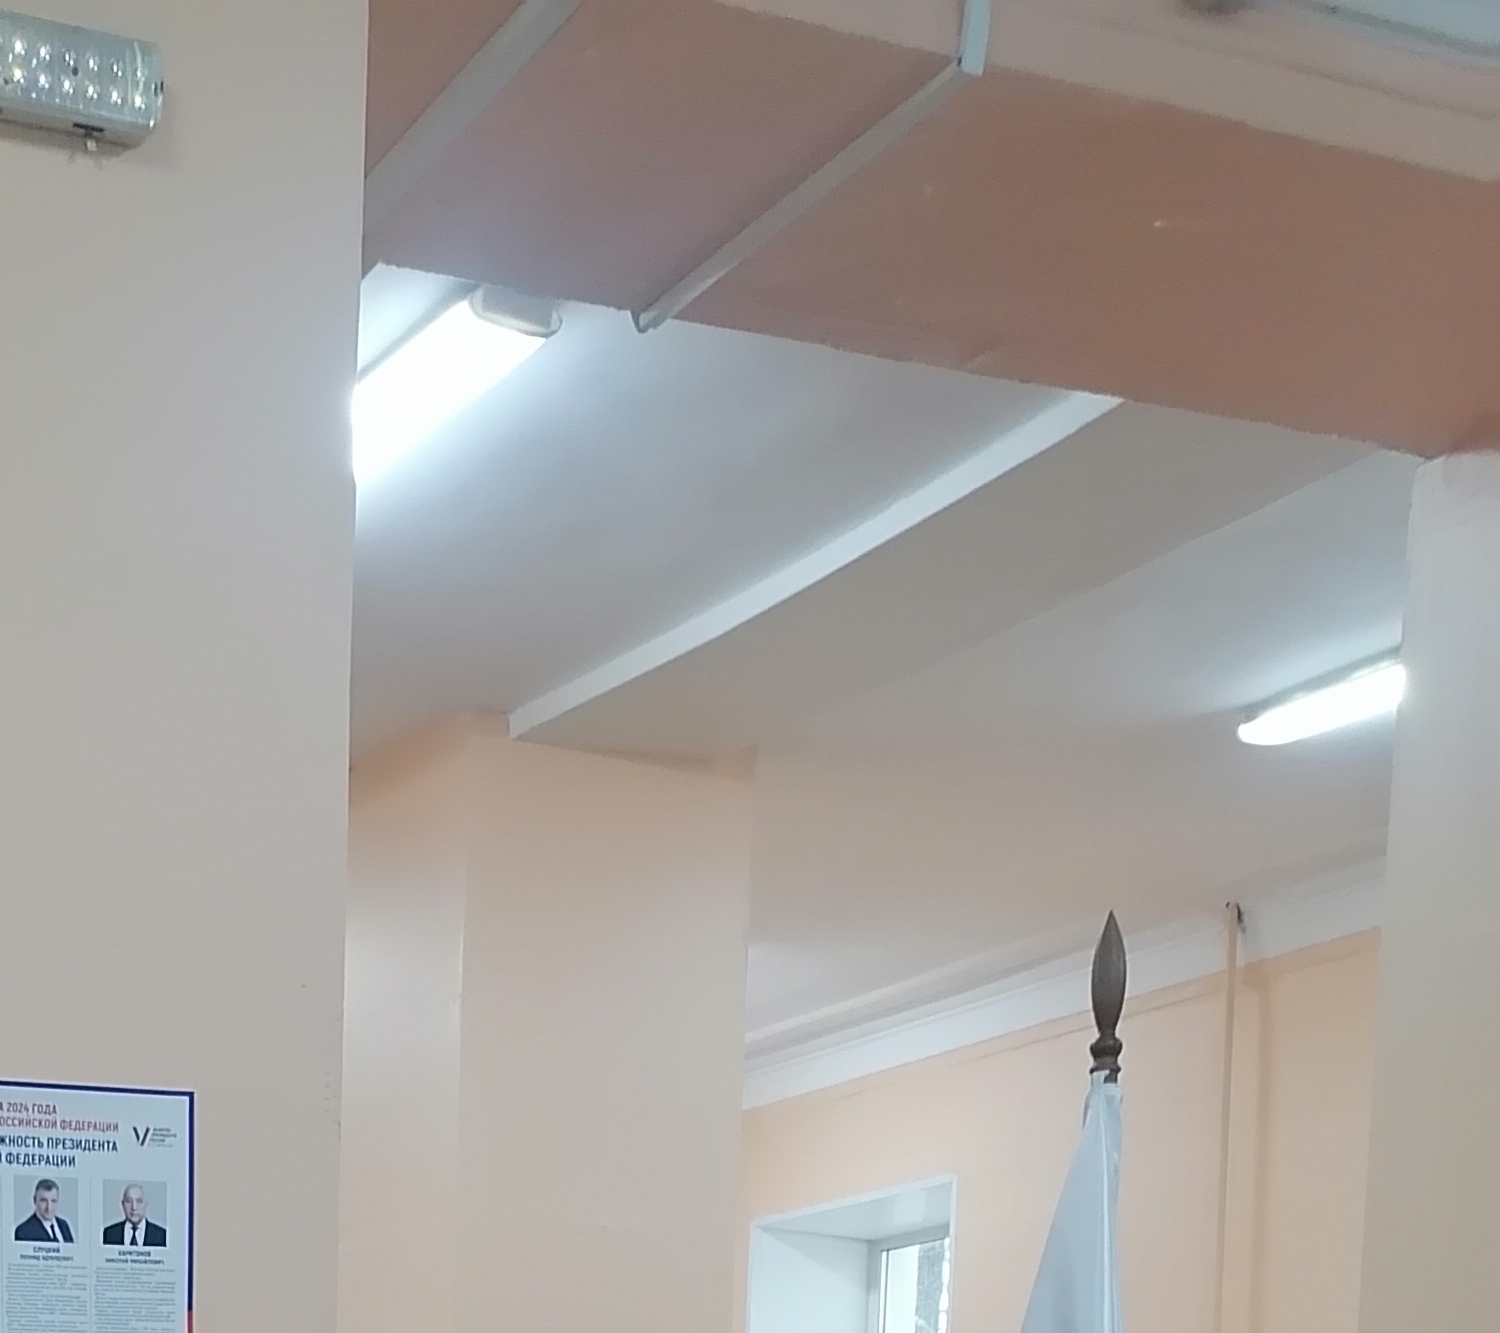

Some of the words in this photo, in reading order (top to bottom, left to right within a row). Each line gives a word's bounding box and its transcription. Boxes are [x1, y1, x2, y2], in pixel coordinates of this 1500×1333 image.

[7, 1102, 29, 1114] 2024
[32, 1103, 58, 1116] ГОДА
[59, 1119, 119, 1133] ФЕДЕРАЦИИ
[46, 1136, 118, 1153] ПРЕЗИДЕНТА
[5, 1151, 76, 1168] ФЕДЕРАЦИИ
